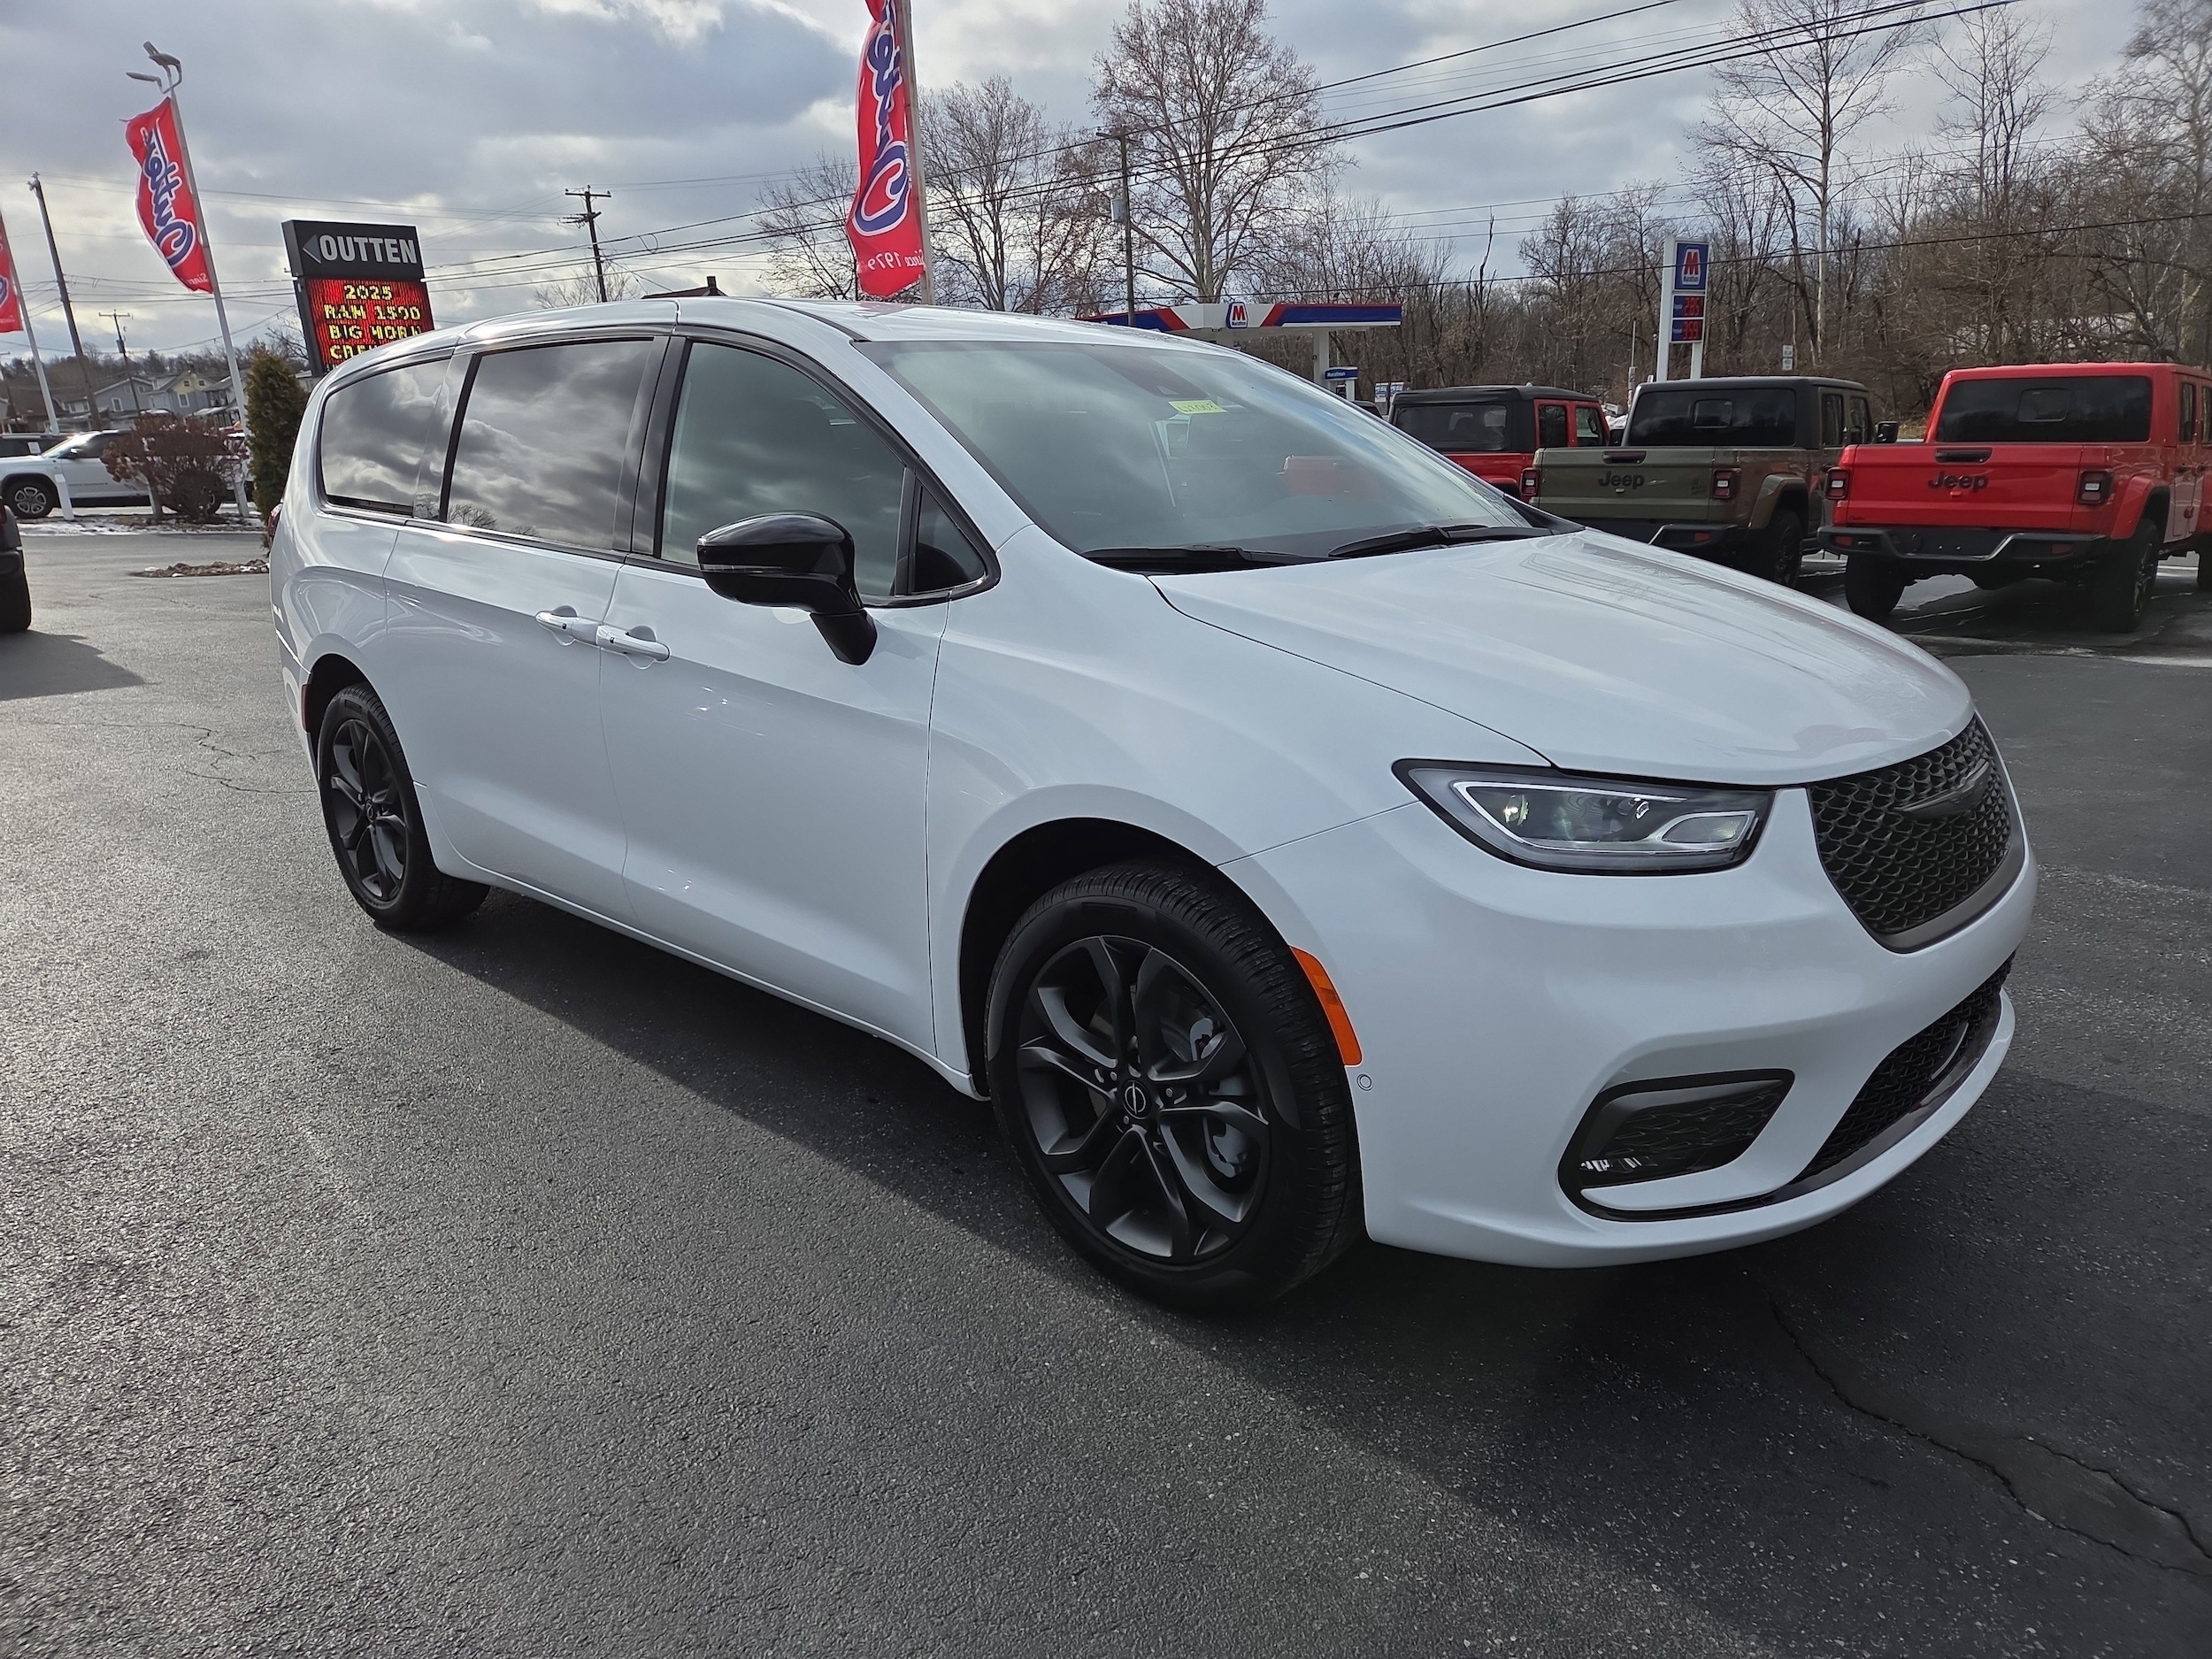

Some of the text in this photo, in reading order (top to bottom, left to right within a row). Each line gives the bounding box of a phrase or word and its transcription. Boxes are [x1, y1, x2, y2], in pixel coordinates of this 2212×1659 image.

[319, 234, 418, 264] OUTTEN
[343, 284, 393, 301] 2025
[324, 303, 421, 320] RAM 1500
[329, 324, 363, 340] BIG
[1598, 471, 1645, 489] Jeep
[1928, 471, 1988, 493] Jeep
